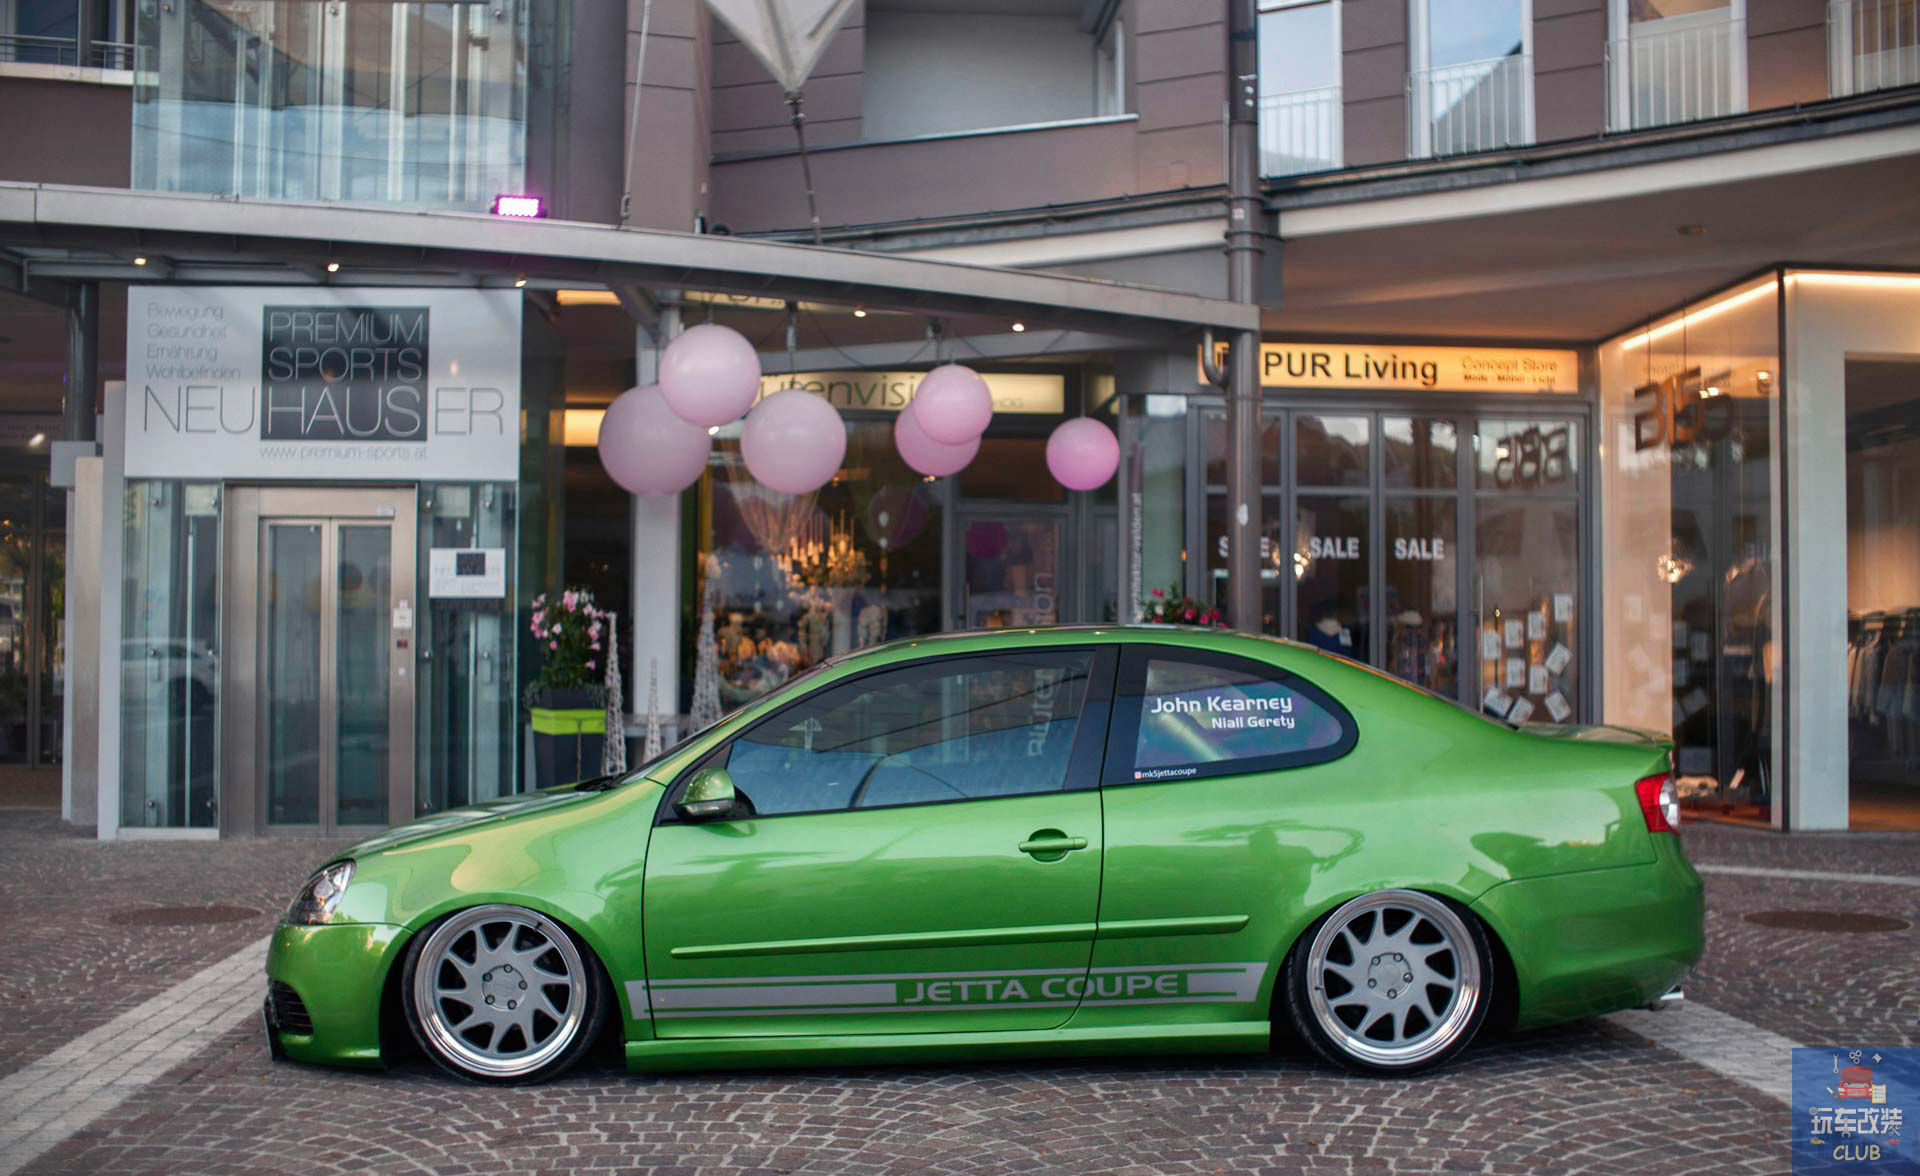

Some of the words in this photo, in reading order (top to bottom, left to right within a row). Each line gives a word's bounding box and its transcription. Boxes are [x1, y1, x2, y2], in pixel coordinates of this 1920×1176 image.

[147, 302, 223, 321] Bewegung
[147, 322, 228, 338] Gesundheit
[269, 311, 423, 344] PREMIUM
[146, 343, 218, 362] Ernährung
[145, 364, 241, 379] Wohlbefinden
[268, 347, 422, 383] SPORTS
[1264, 352, 1332, 378] PUR
[1344, 352, 1438, 386] Living
[1462, 356, 1518, 374] Concept
[1523, 358, 1558, 371] Store
[260, 445, 427, 462] www.premium-sports.at
[1219, 536, 1270, 558] SE
[1309, 537, 1360, 559] SALE
[1395, 538, 1445, 560] SALE
[1151, 697, 1201, 714] John
[1207, 696, 1293, 713] Kearney
[1212, 717, 1244, 729] Niall
[1247, 715, 1295, 729] Gerety
[1142, 767, 1197, 780] mk5jettacoupe
[904, 979, 1030, 1003] JETTA
[1041, 974, 1179, 999] COUPE
